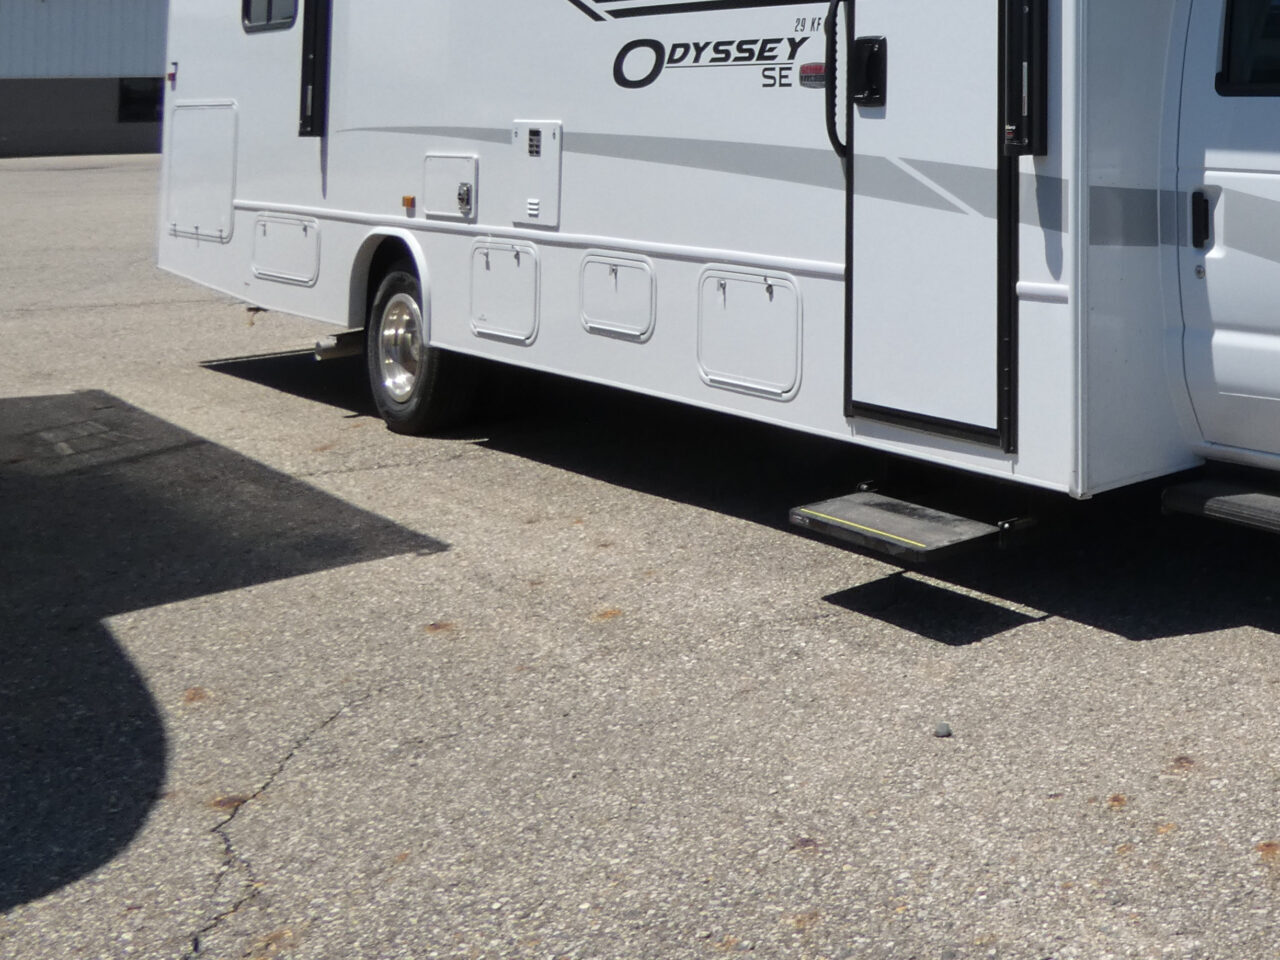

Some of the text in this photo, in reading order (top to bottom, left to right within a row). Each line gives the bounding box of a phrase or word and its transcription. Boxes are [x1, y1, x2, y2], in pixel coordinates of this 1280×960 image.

[794, 17, 822, 32] 29 KF
[613, 36, 811, 89] ODYSSEY
[762, 67, 793, 88] SE
